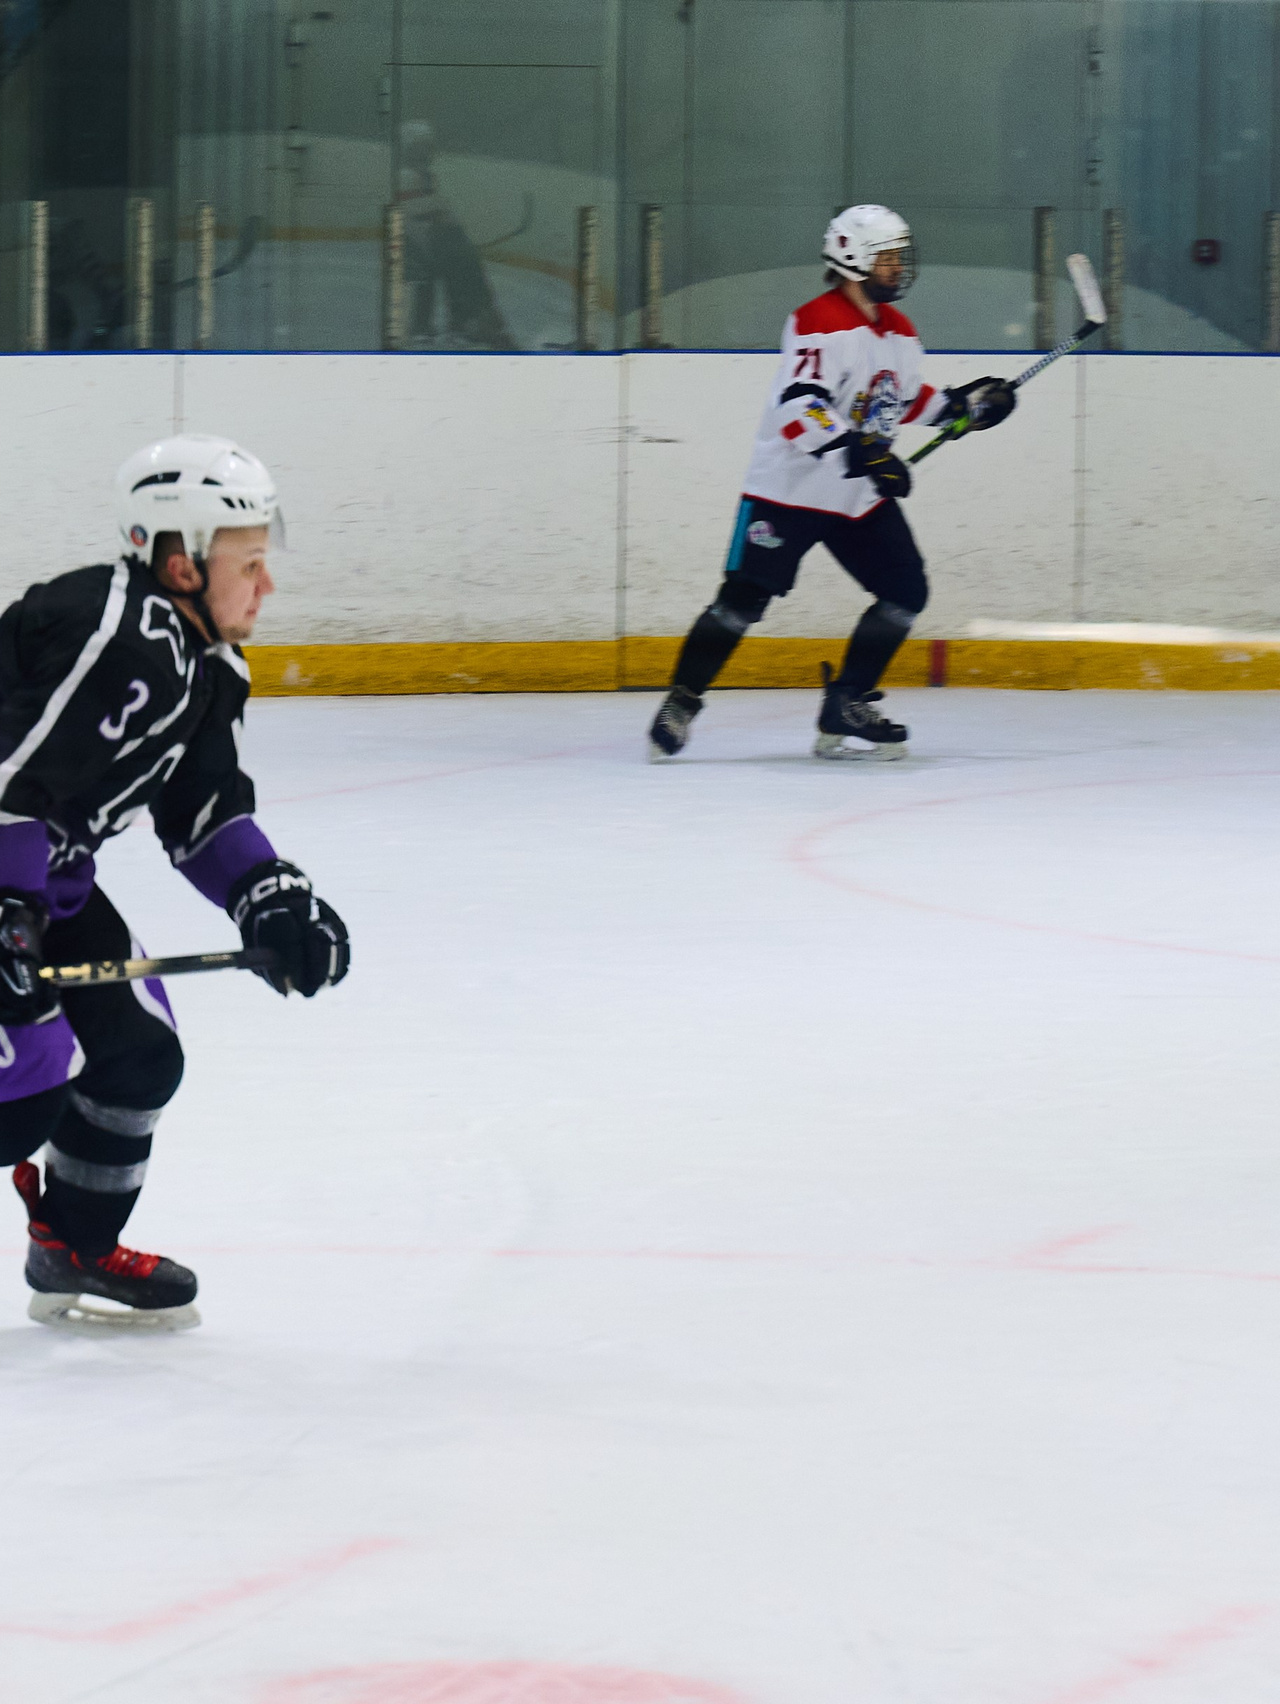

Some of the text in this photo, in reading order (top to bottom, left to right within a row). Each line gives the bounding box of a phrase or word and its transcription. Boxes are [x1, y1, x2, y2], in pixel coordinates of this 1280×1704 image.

[794, 347, 823, 379] 71
[99, 679, 150, 740] 3
[233, 873, 310, 929] CCM
